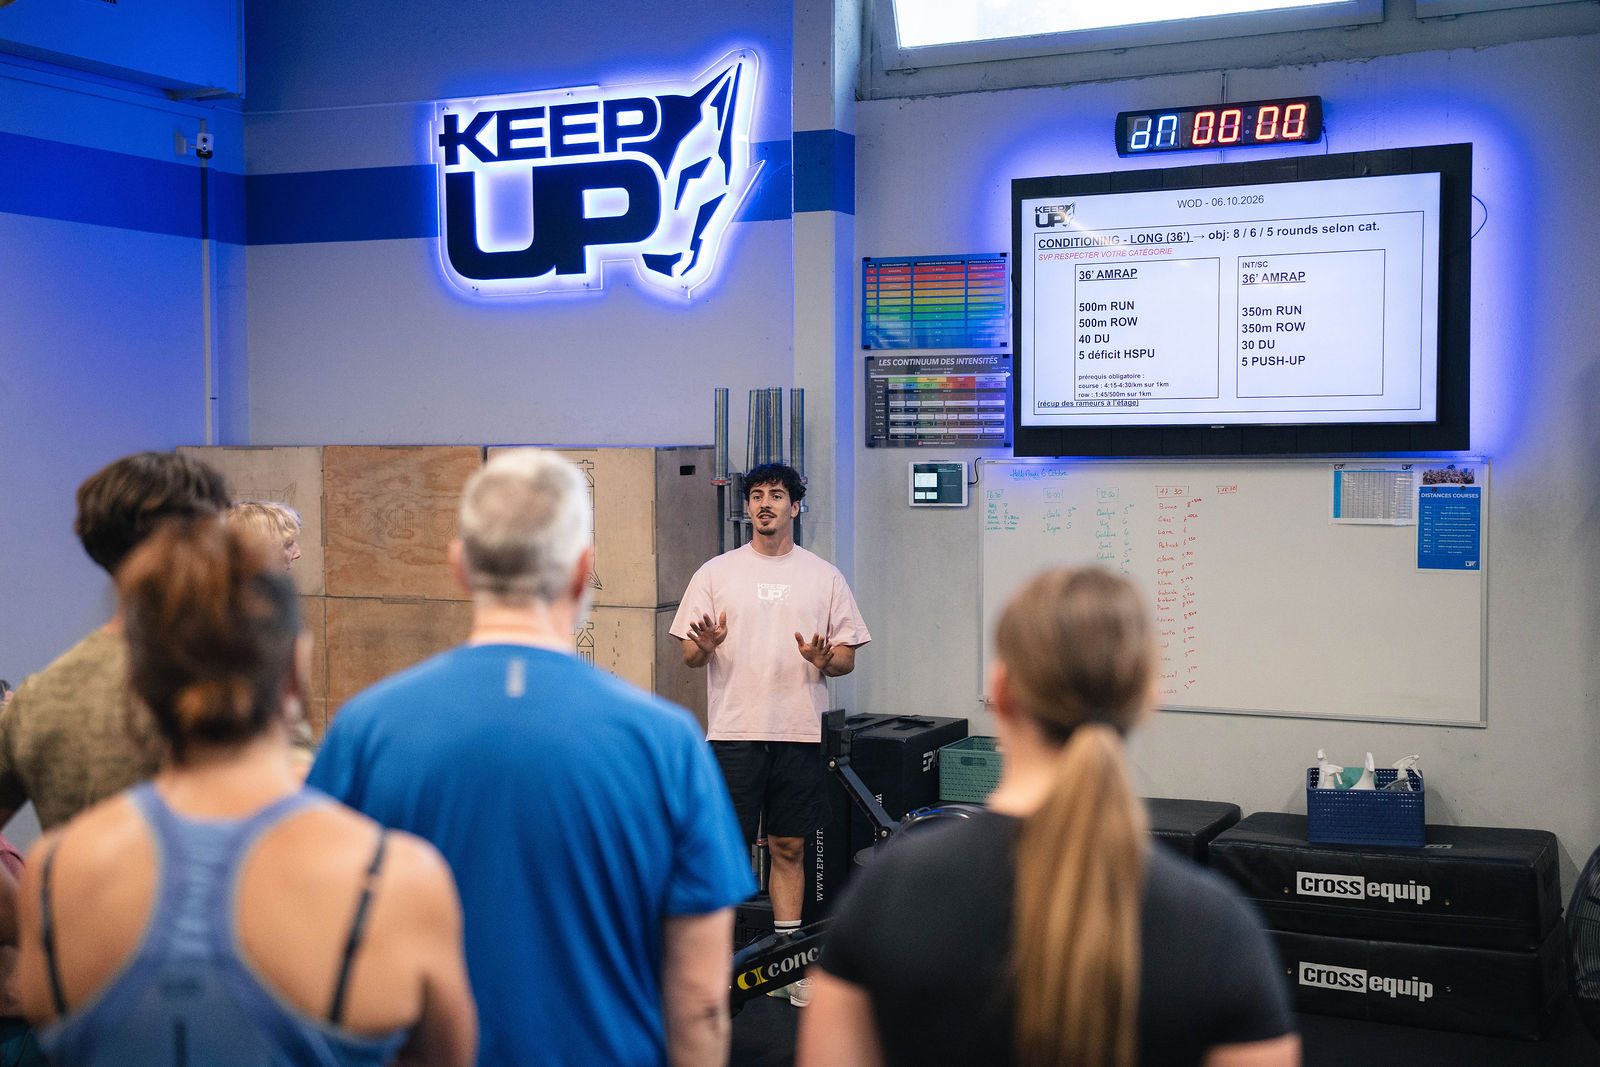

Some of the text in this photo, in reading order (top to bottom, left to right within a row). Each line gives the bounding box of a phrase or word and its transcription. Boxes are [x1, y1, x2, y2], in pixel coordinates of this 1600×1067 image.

[438, 96, 658, 165] KEEP
[1177, 199, 1203, 209] WOD
[1211, 195, 1265, 207] 06.10.2026
[1035, 204, 1066, 213] KEEP
[445, 159, 661, 281] UP
[1035, 212, 1066, 228] UP
[1038, 235, 1120, 249] CONDITIONING
[1130, 233, 1163, 244] LONG
[1208, 228, 1230, 242] obj:
[1233, 229, 1240, 239] 8
[1250, 228, 1257, 238] 6
[1267, 227, 1274, 237] 5
[1277, 225, 1319, 236] rounds
[1322, 222, 1355, 234] selon
[1358, 221, 1380, 232] cat.
[1038, 253, 1053, 261] SVP
[1055, 252, 1099, 260] RESPECTER
[1129, 247, 1173, 256] CATÉGORIE
[1242, 261, 1268, 269] INT/SC
[1096, 269, 1138, 279] AMRAP
[1261, 272, 1306, 282] AMRAP
[1078, 301, 1135, 312] 500m RUN
[1242, 305, 1302, 316] 350m RUN
[1078, 317, 1138, 328] 500m ROW
[1242, 322, 1306, 333] 350m ROW
[1078, 334, 1110, 344] 40 DU
[1242, 339, 1275, 350] 30 DU
[1078, 349, 1155, 360] 5 déficit HSPU
[892, 358, 939, 366] CONTINUUM
[956, 357, 998, 365] INTENSITÉS
[1242, 356, 1306, 366] 5 PUSH-UP
[767, 946, 823, 978] conc
